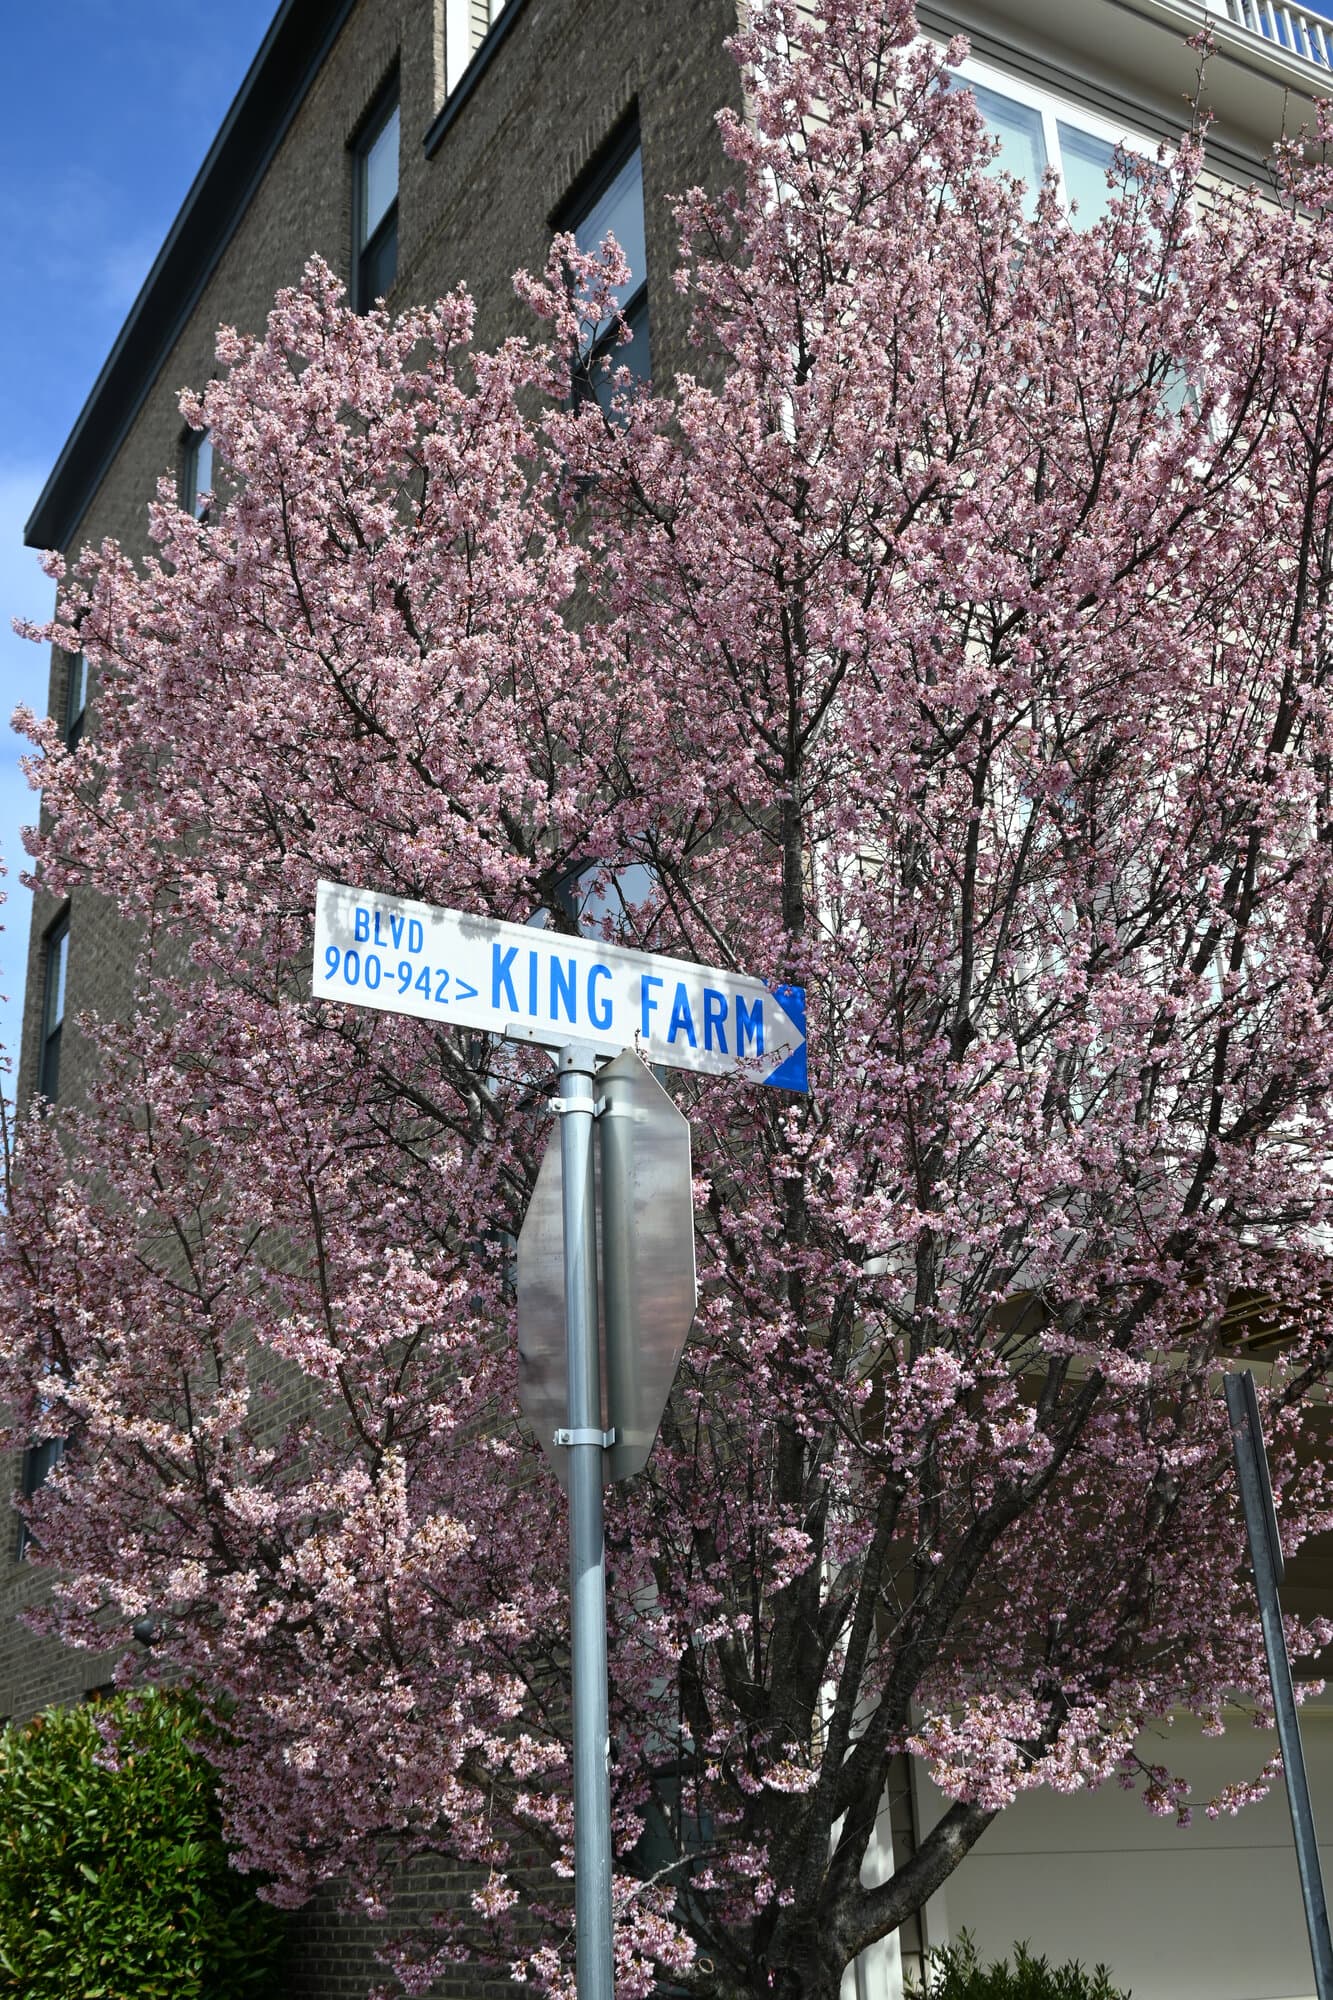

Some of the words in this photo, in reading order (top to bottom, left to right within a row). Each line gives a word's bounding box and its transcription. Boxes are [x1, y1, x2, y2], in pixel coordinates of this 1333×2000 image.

[353, 906, 424, 955] BLVD
[491, 942, 614, 1031] KING
[639, 974, 766, 1058] FARM
